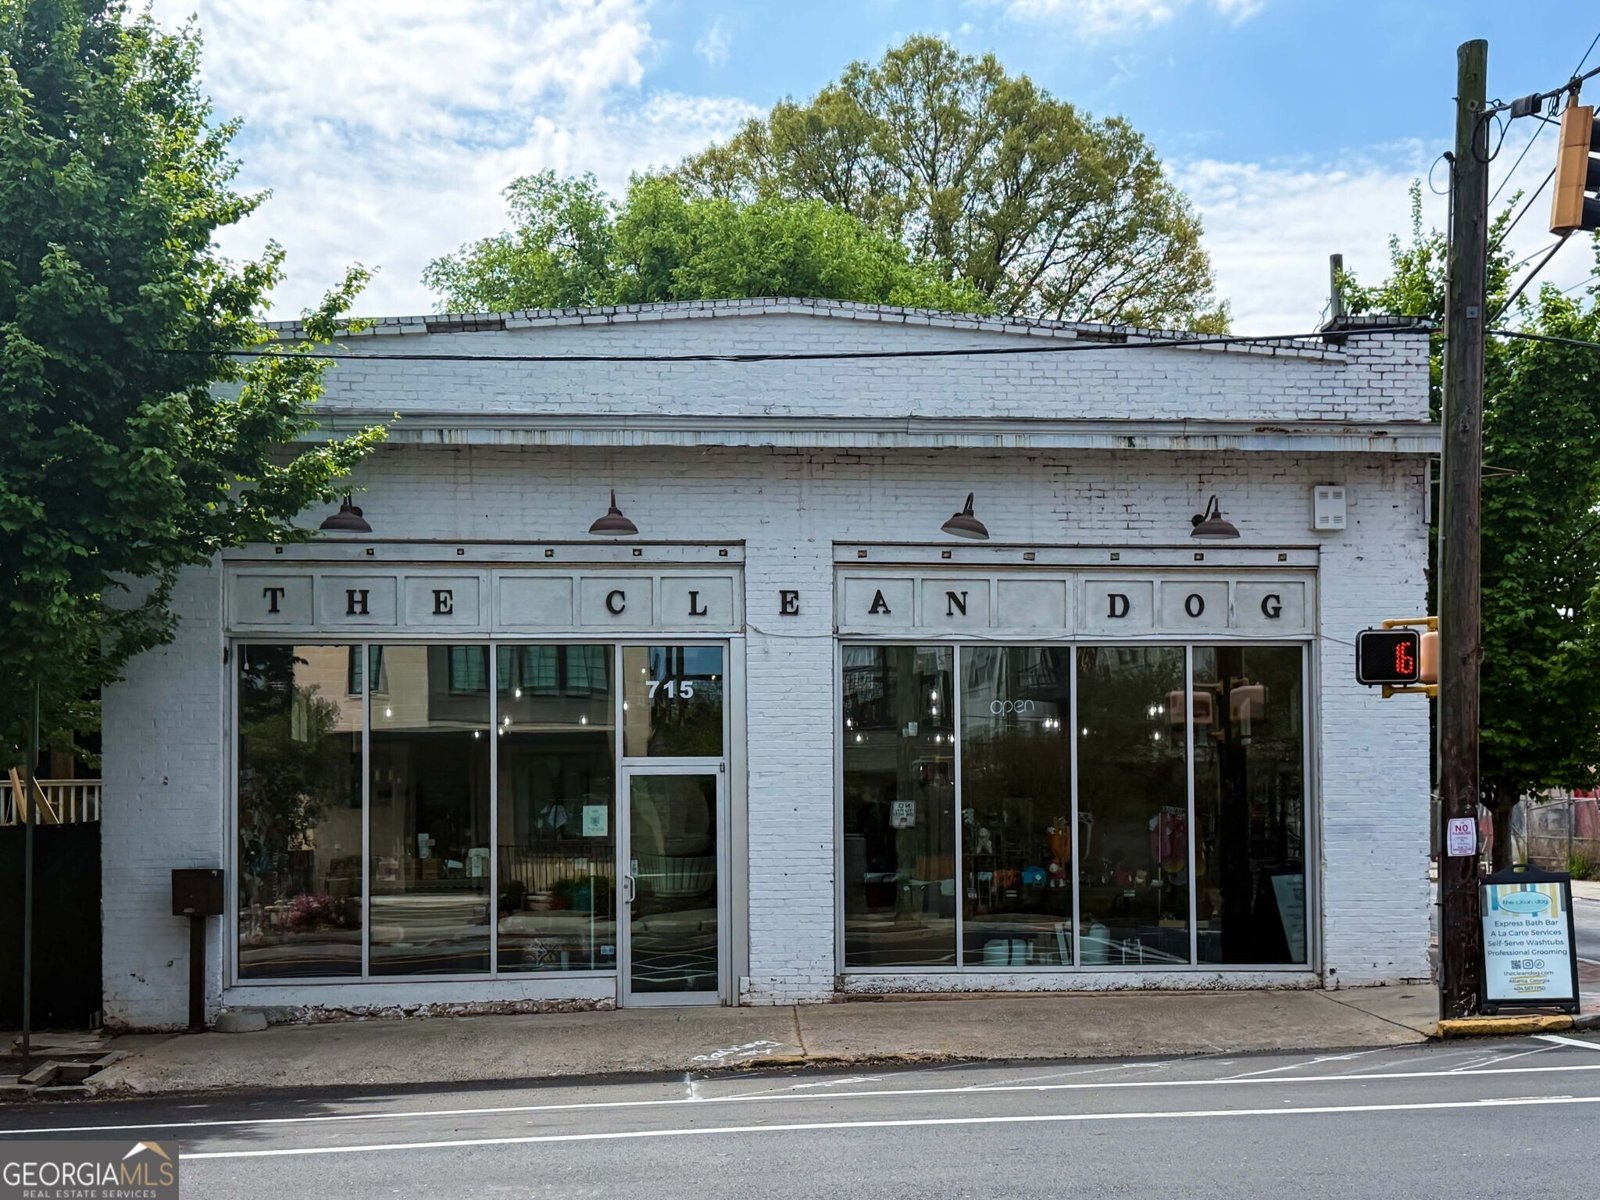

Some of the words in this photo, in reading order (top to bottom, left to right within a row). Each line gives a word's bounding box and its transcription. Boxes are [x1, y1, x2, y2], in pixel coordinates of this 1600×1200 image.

[263, 587, 454, 616] THE
[605, 589, 968, 616] CLEAN
[1107, 593, 1282, 619] DOG
[645, 680, 694, 699] 715
[990, 699, 1035, 717] open
[1455, 824, 1469, 832] NO
[1494, 920, 1523, 928] Express
[1525, 919, 1544, 927] Bath
[1508, 929, 1530, 937] Carte
[1487, 949, 1530, 957] Professional
[1531, 948, 1568, 956] Grooming
